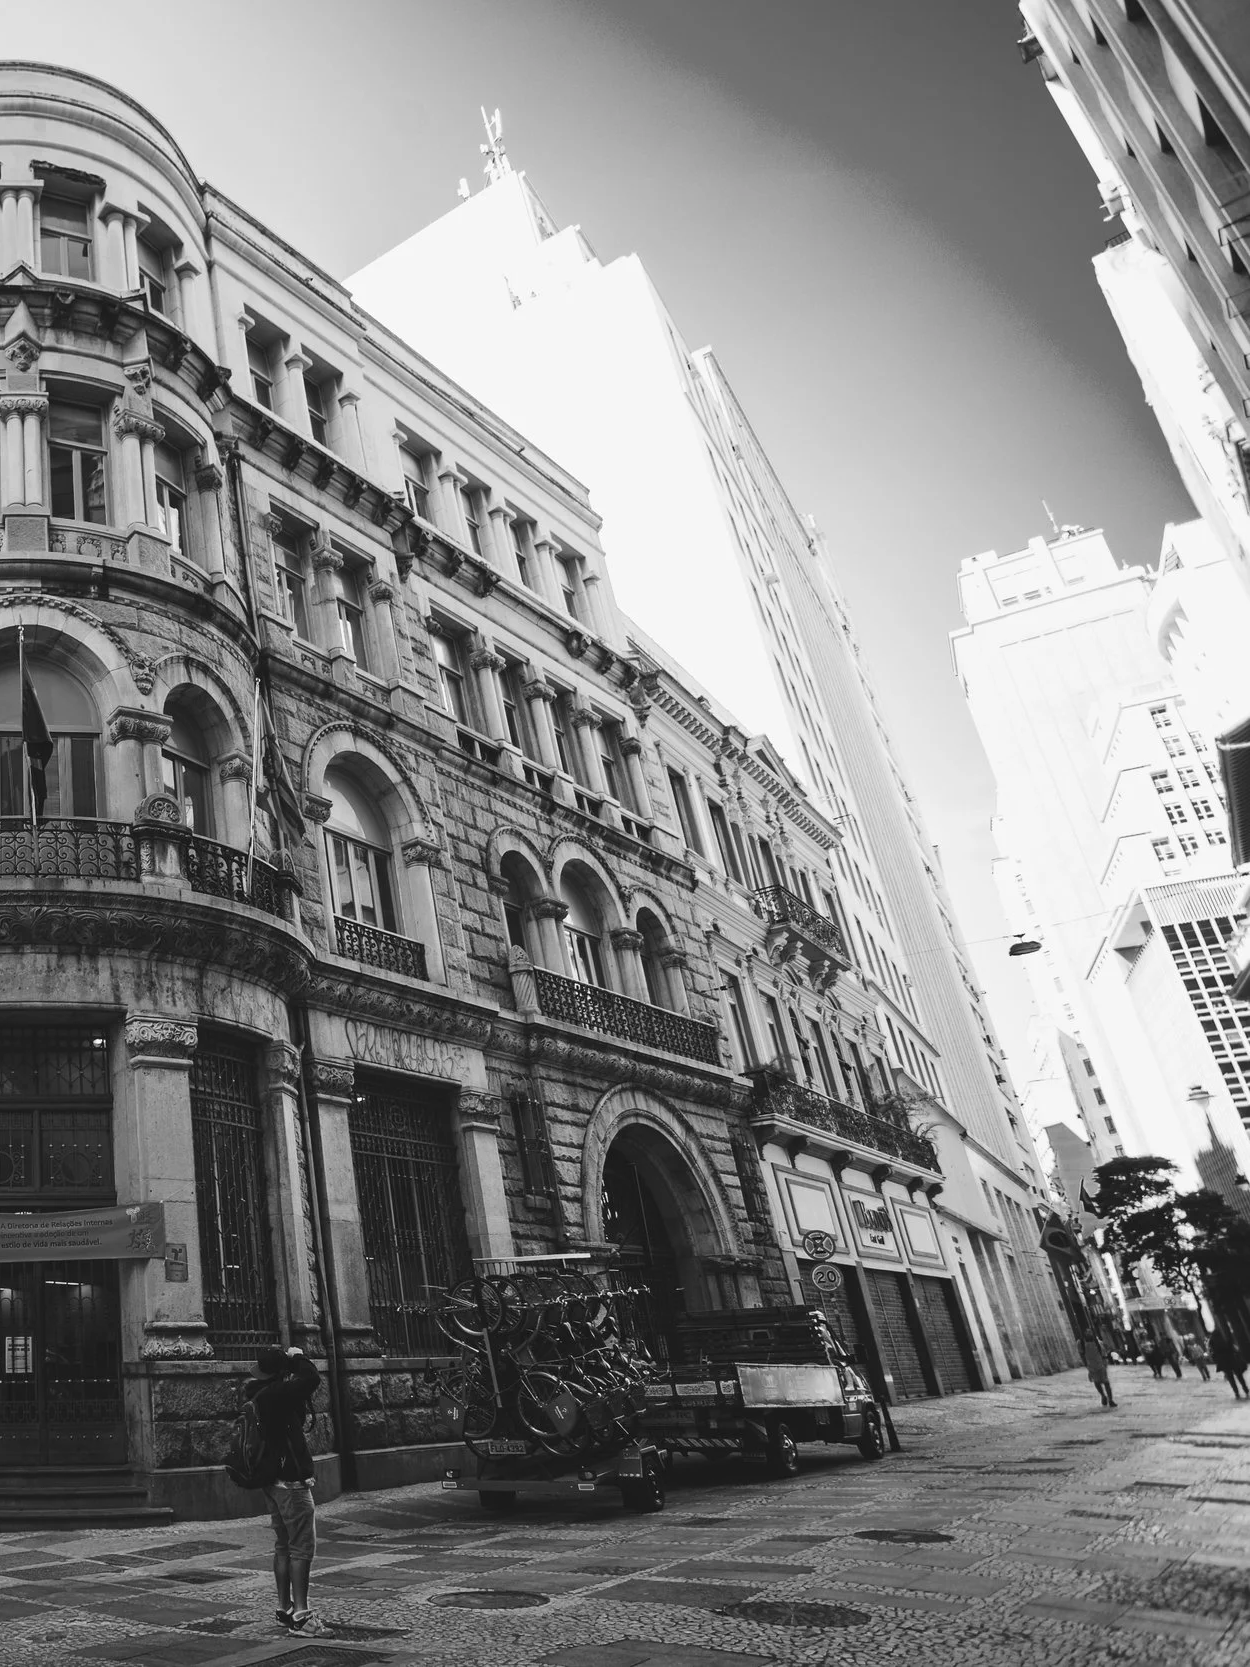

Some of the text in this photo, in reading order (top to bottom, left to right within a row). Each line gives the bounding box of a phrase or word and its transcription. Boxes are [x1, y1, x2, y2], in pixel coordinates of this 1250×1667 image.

[51, 1220, 82, 1229] Relações
[84, 1218, 113, 1226] Internas
[1, 1241, 21, 1249] estilo
[22, 1240, 32, 1248] de
[33, 1240, 48, 1248] vida
[816, 1270, 837, 1283] 20
